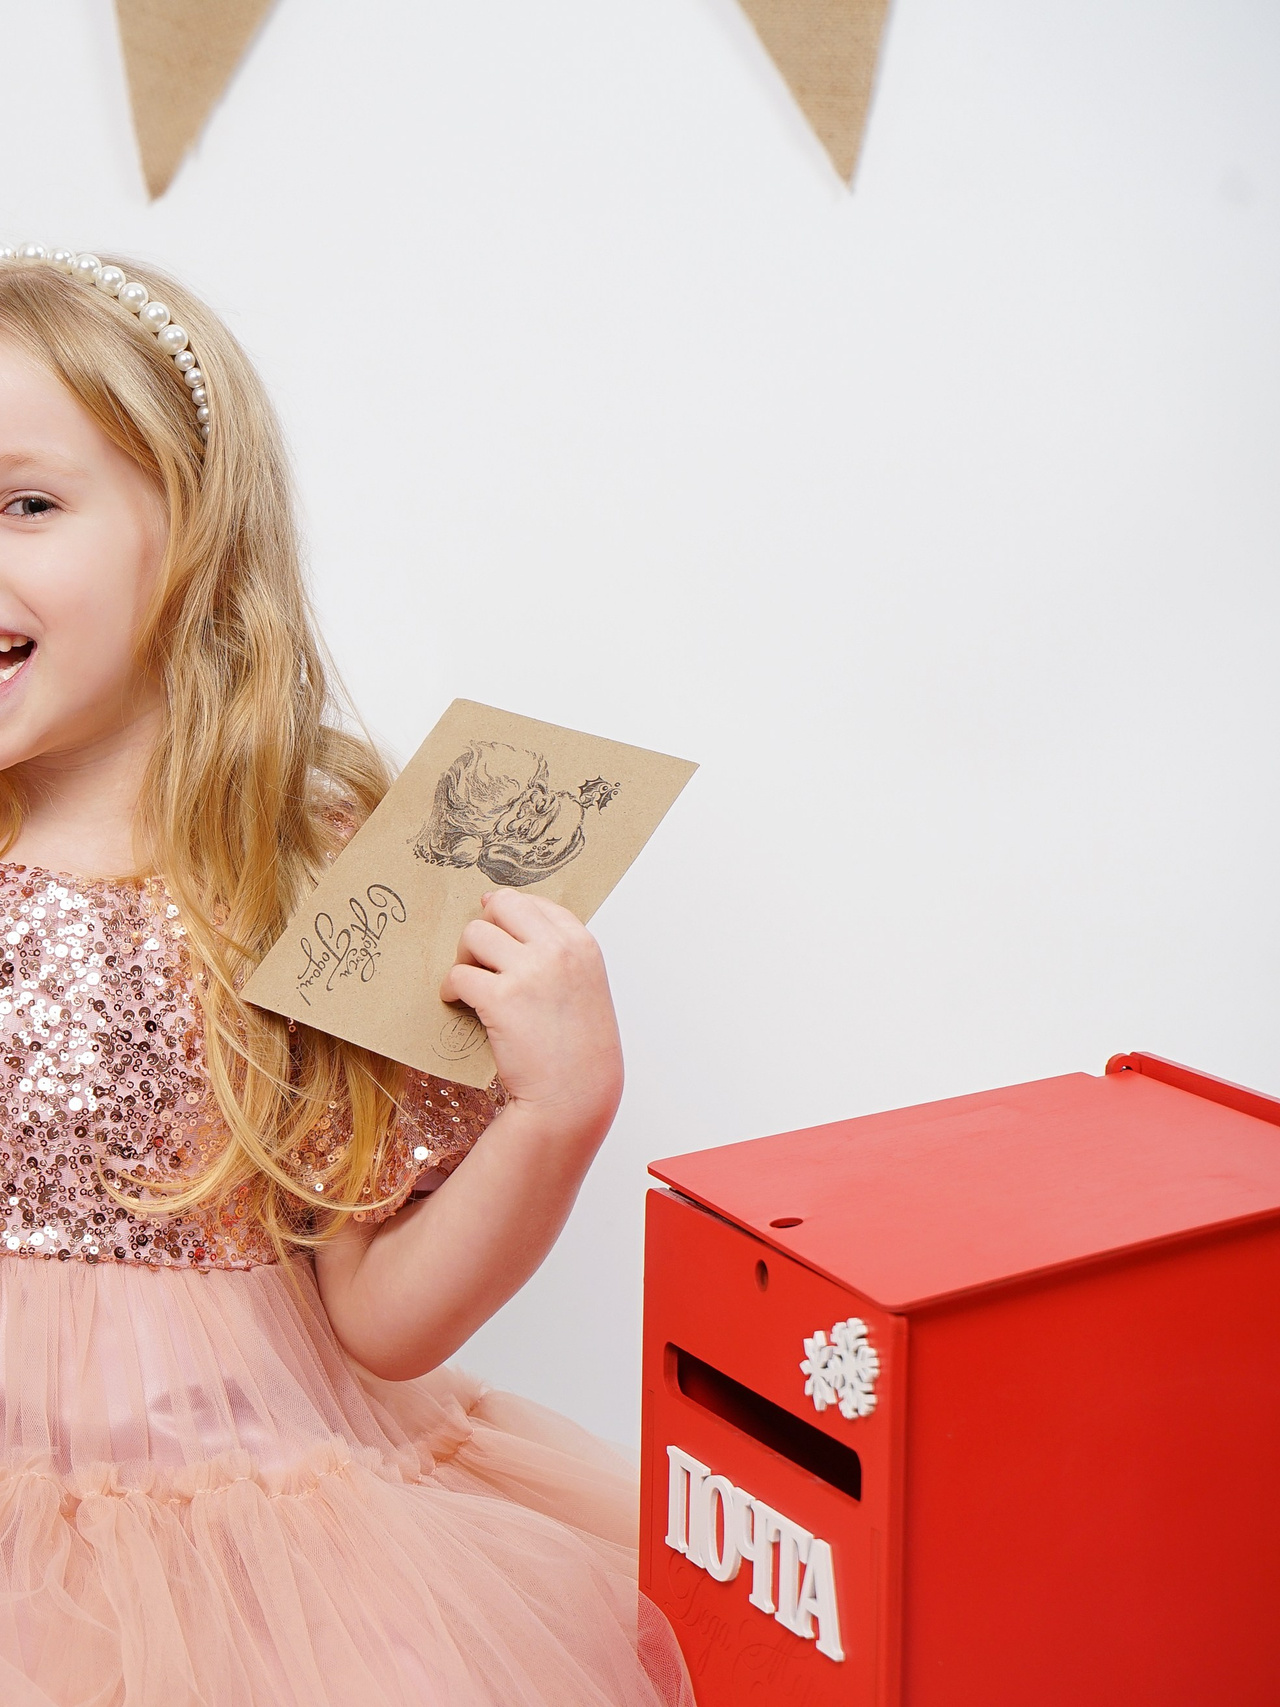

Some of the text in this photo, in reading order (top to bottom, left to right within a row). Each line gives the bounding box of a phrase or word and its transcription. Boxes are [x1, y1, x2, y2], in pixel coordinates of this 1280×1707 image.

[295, 912, 352, 1007] Годом!
[339, 883, 407, 983] С Новым
[664, 1445, 846, 1663] ПОЧТА
